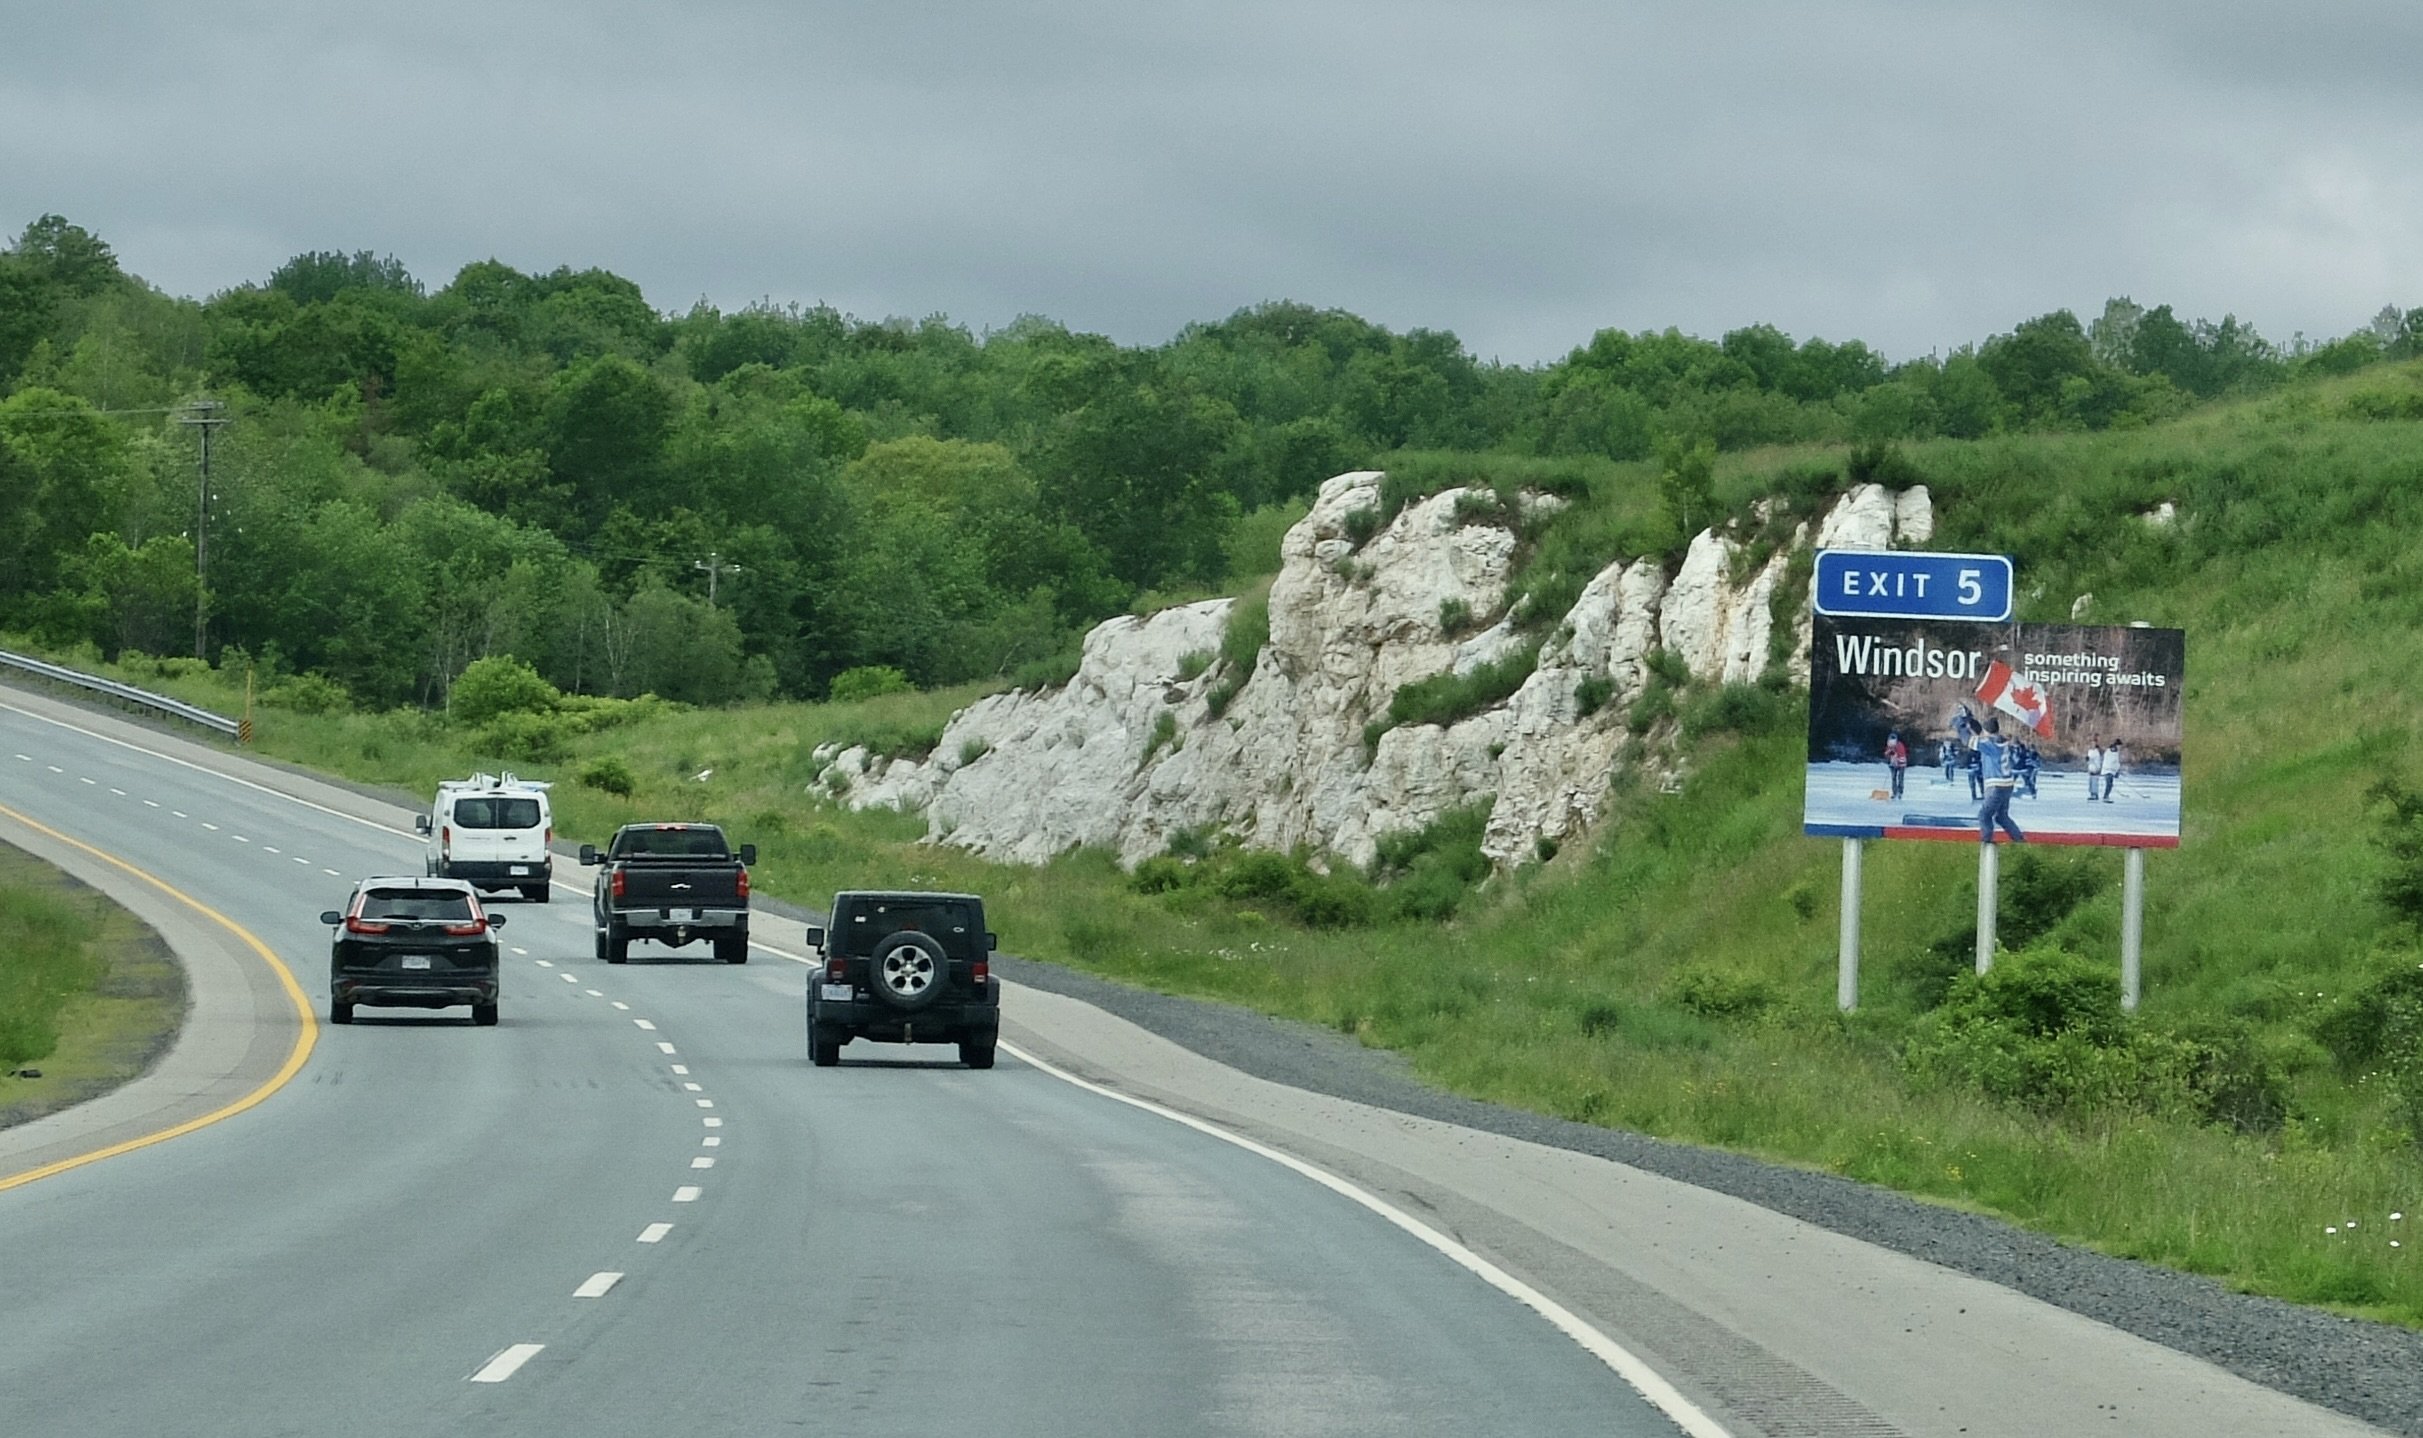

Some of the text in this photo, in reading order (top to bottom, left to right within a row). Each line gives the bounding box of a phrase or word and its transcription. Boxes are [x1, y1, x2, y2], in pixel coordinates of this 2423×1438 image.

[1843, 569, 1982, 605] EXIT 5
[1836, 634, 1982, 679] Windsor
[2024, 652, 2120, 672] something
[2024, 666, 2166, 687] inspiring awaits
